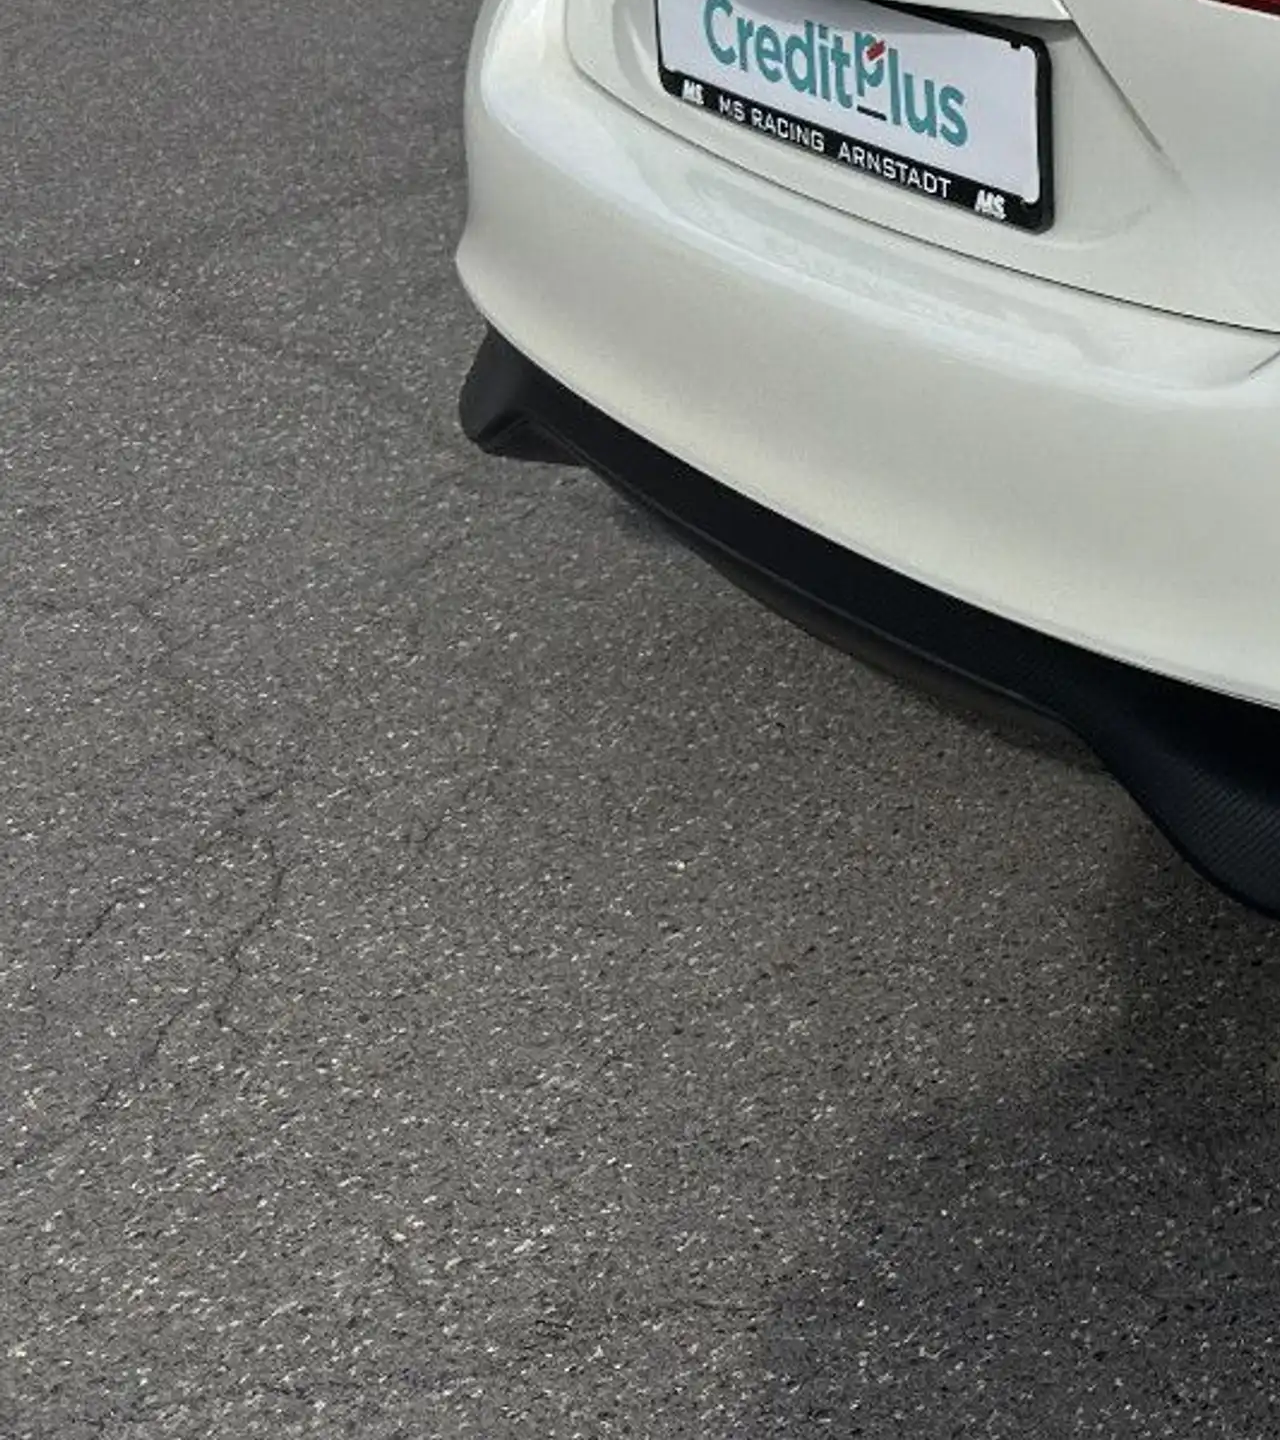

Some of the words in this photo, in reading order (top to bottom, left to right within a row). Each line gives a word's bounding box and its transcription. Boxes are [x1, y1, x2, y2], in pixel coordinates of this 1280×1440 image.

[719, 95, 746, 123] MS
[751, 106, 825, 153] RACING
[838, 140, 951, 199] ARNSTADT
